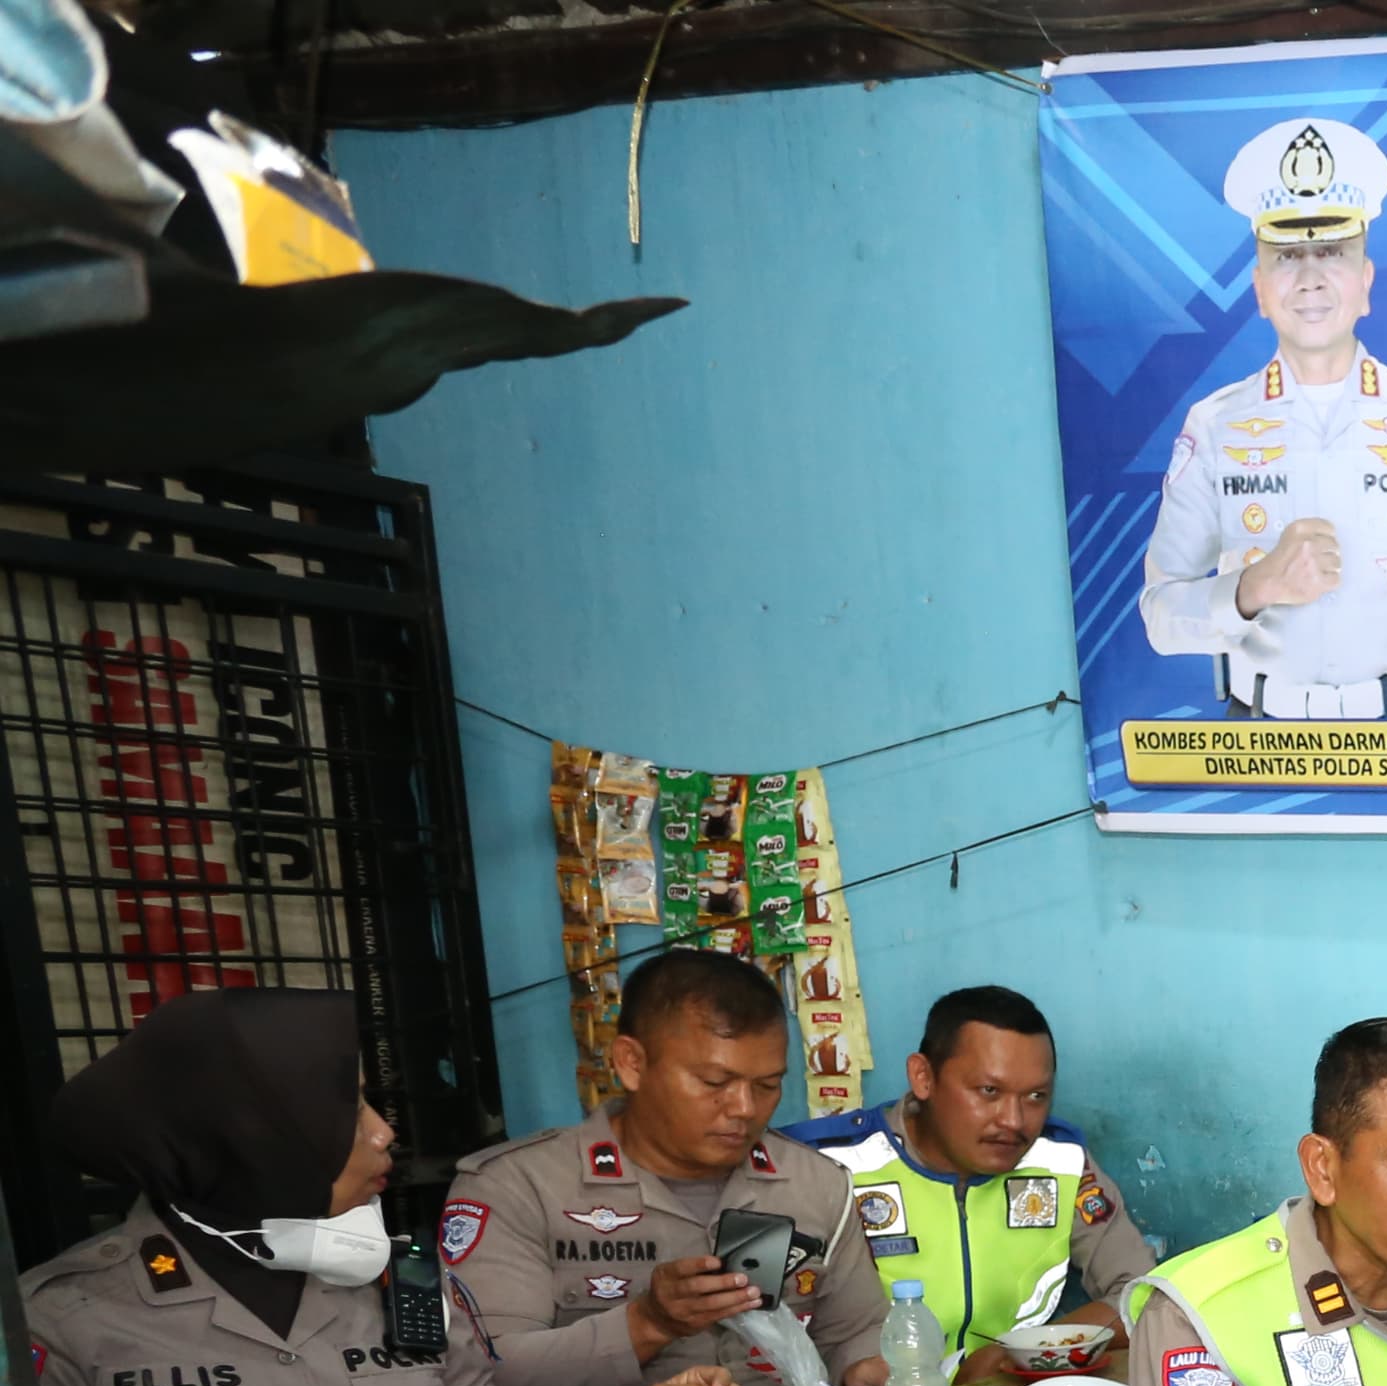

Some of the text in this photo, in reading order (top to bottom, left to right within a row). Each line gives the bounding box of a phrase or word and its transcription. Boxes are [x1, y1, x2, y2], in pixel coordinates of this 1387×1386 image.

[1222, 473, 1288, 496] FIRMAN
[1135, 731, 1206, 751] KOMBES
[1211, 732, 1245, 751] POL
[1250, 732, 1323, 752] FIRMAN
[1205, 757, 1307, 776] DIRLANTAS
[1313, 757, 1373, 776] POLDA
[758, 779, 784, 790] MILO
[759, 840, 784, 852] MILO
[367, 963, 386, 1016] ANKER
[1170, 1352, 1198, 1368] LALU
